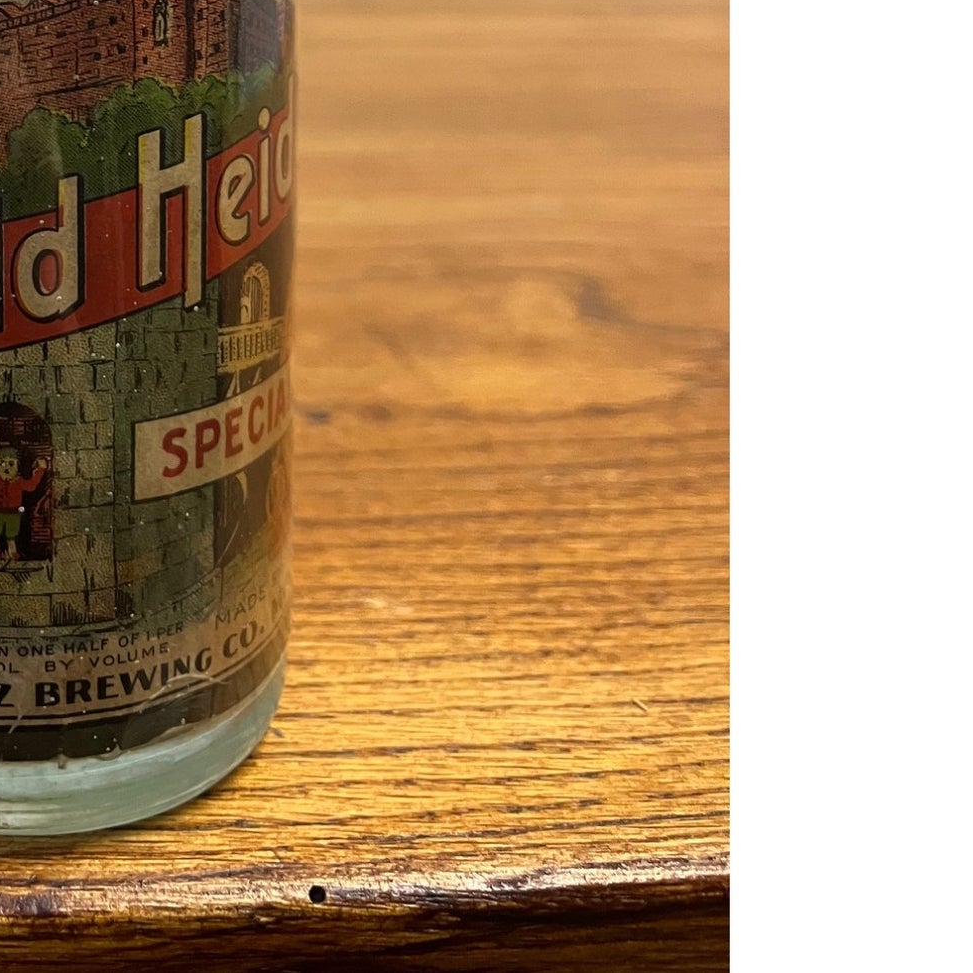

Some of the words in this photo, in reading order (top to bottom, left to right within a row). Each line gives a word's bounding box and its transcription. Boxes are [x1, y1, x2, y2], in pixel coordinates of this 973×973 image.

[17, 643, 56, 658] ONE
[63, 638, 110, 655] HALF
[118, 631, 140, 647] OF
[156, 621, 184, 640] PER
[44, 659, 74, 673] BY
[88, 641, 170, 668] VOLUME
[35, 646, 213, 708] BREWING
[222, 619, 265, 660] CO.
